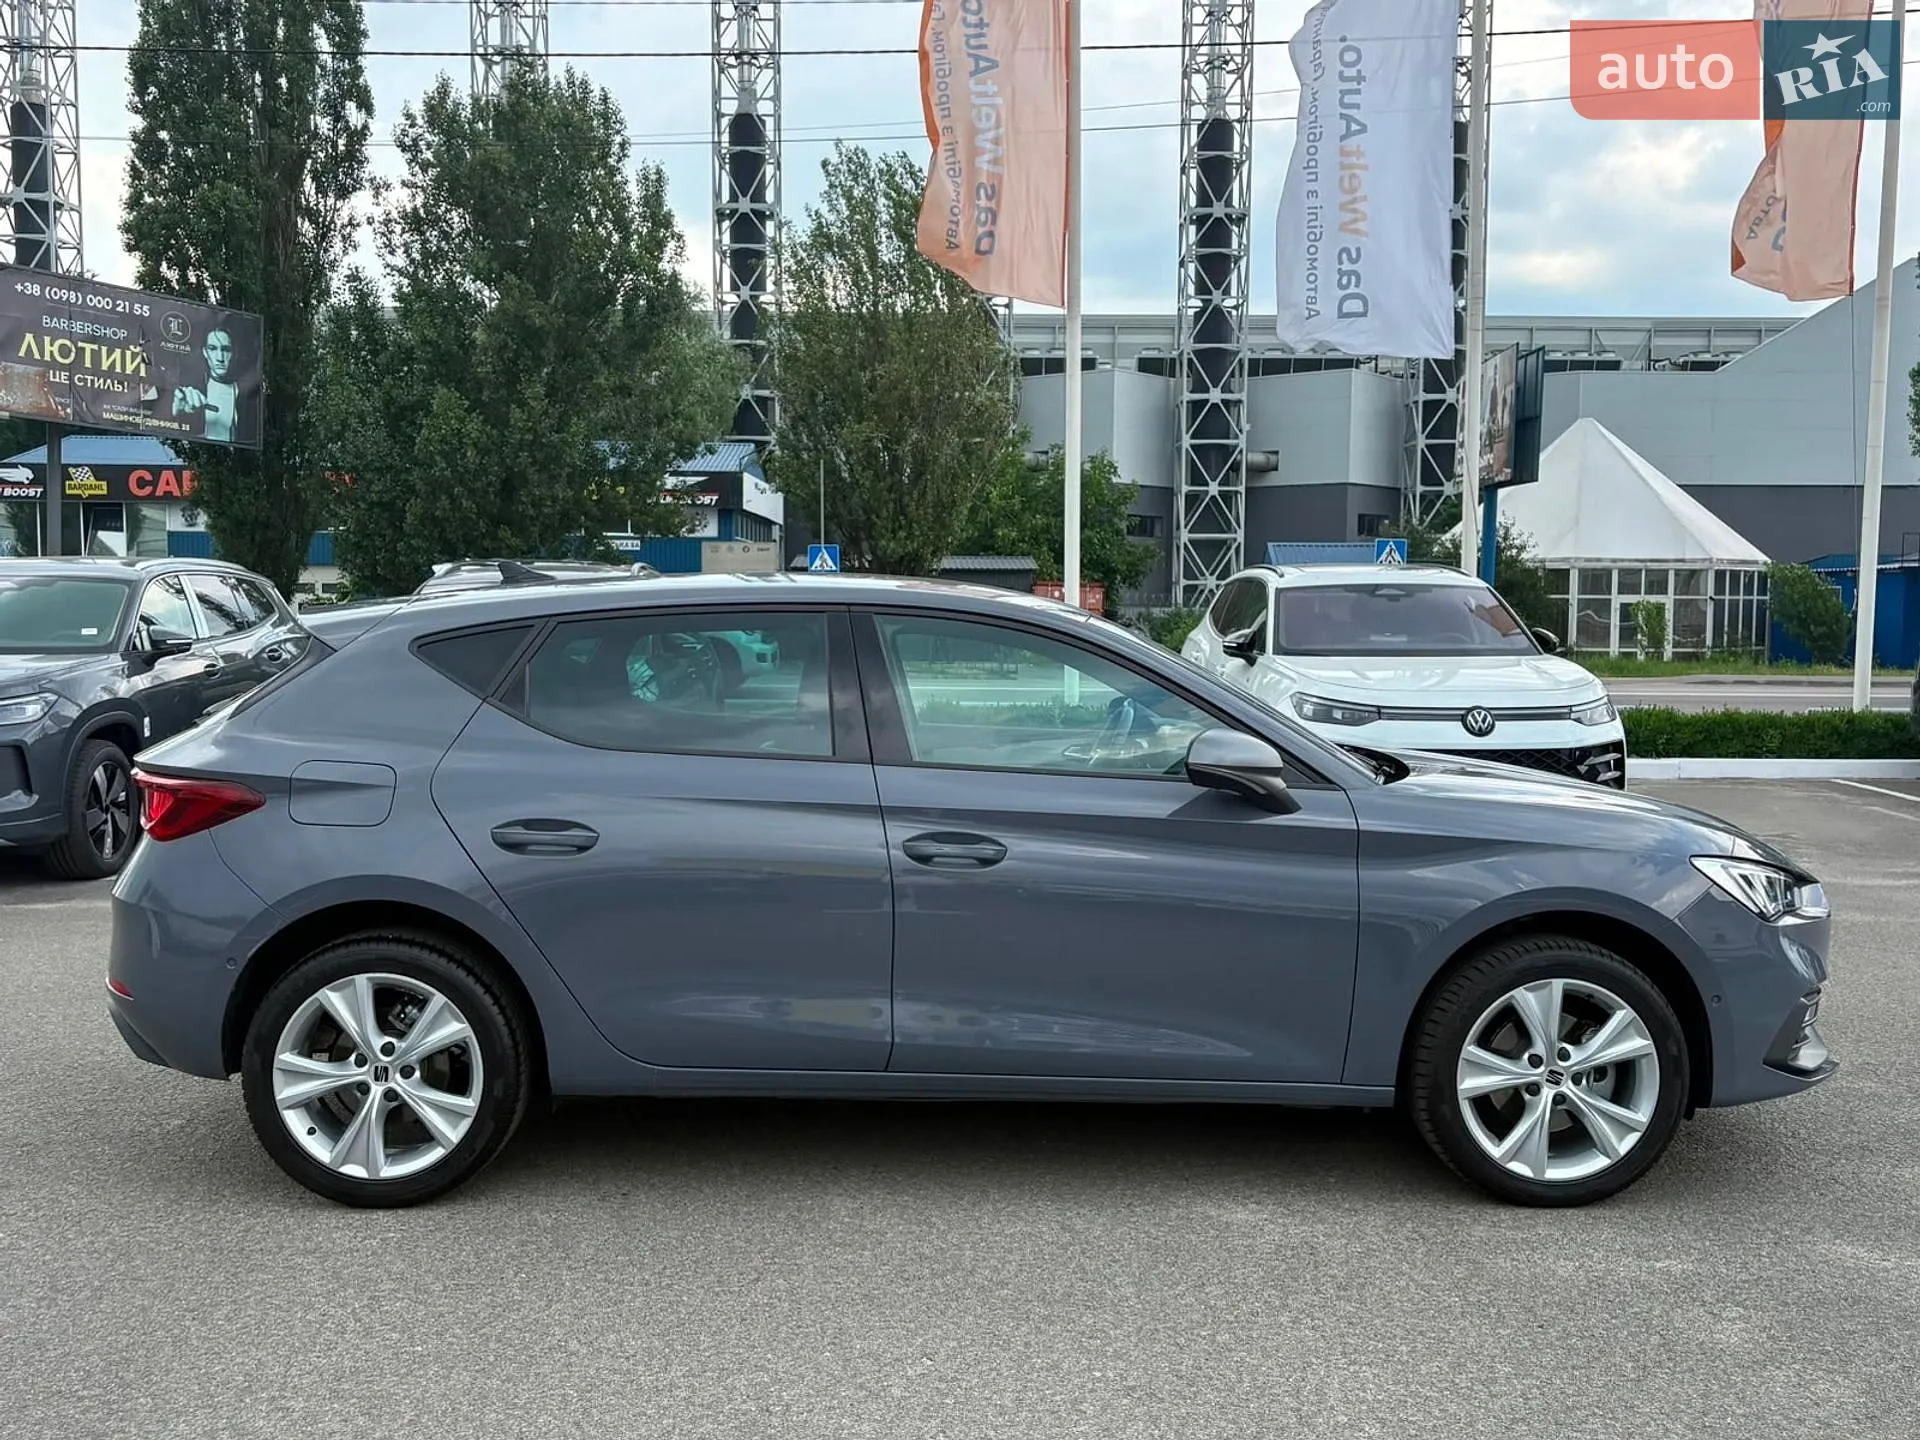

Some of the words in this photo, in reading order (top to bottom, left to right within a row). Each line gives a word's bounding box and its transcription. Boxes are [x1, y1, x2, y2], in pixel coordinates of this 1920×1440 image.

[14, 282, 41, 297] +38
[45, 286, 82, 305] (098)
[86, 294, 112, 310] 000
[115, 300, 129, 313] 21
[133, 303, 150, 317] 55
[42, 315, 128, 340] BARBERSHOP
[18, 332, 148, 377] ЛЮТИЙ
[50, 369, 70, 384] ЦЕ
[74, 374, 128, 393] СТИЛЬ!
[3, 487, 44, 498] BOOST
